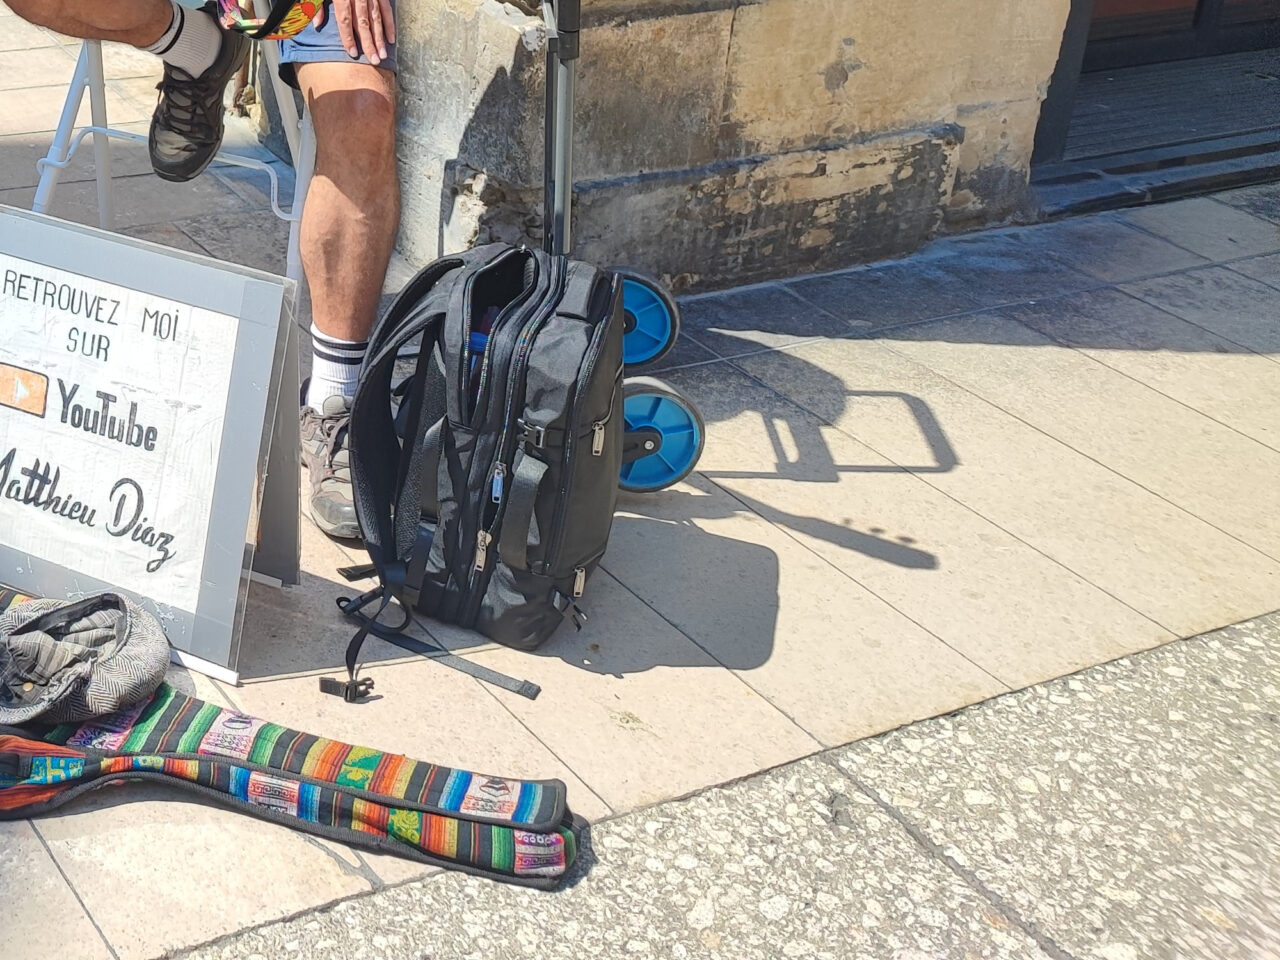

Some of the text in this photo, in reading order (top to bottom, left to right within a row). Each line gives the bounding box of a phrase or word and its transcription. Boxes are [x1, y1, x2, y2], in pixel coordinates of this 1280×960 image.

[2, 269, 121, 327] RETROUVEZ
[66, 327, 111, 362] SUR
[56, 377, 159, 452] YouTube
[104, 477, 177, 573] Diaz
